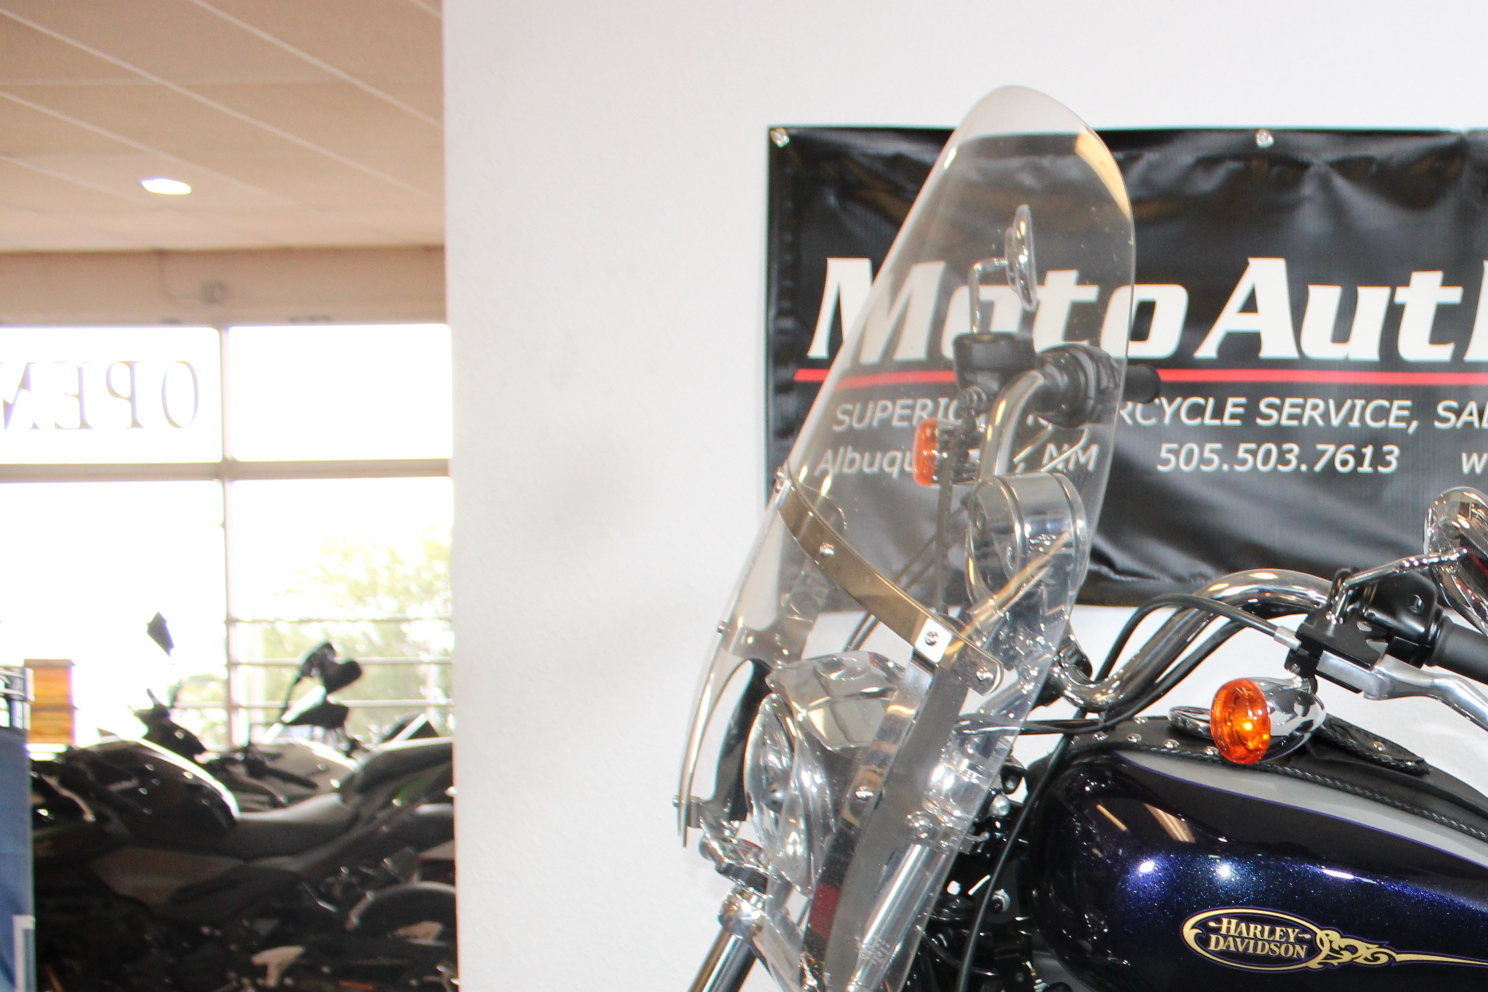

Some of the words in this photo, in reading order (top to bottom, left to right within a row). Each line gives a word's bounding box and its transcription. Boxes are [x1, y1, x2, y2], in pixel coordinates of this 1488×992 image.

[807, 256, 1190, 364] Moto
[1255, 398, 1420, 434] SERVICE,
[1156, 443, 1401, 473] 505.503.7613
[1219, 917, 1300, 943] HARLEY
[1207, 933, 1308, 959] DAVIDSON
